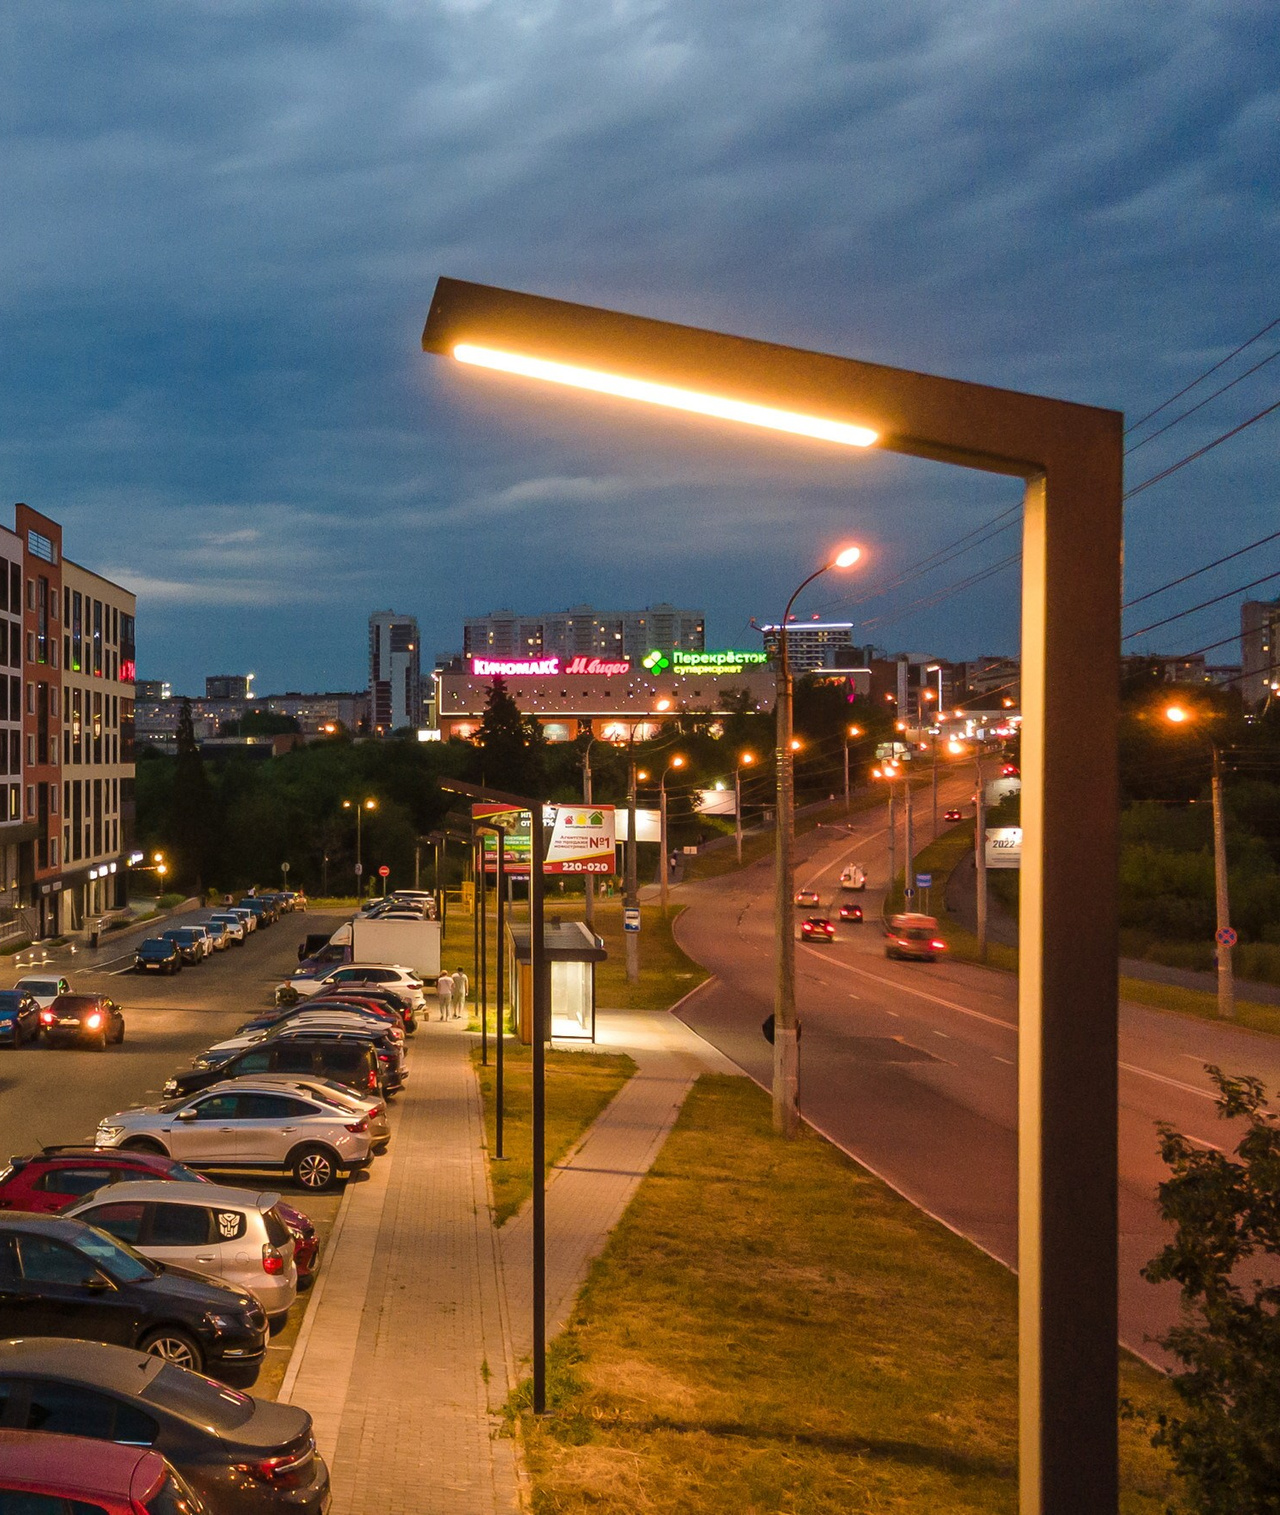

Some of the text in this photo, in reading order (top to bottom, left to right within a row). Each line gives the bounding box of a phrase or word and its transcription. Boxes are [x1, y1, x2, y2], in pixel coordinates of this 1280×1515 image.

[673, 651, 767, 665] Перекрёсток
[565, 657, 629, 677] М.видео
[673, 665, 743, 675] супермаркет
[992, 840, 1015, 848] 2022
[562, 862, 609, 872] 220-020
